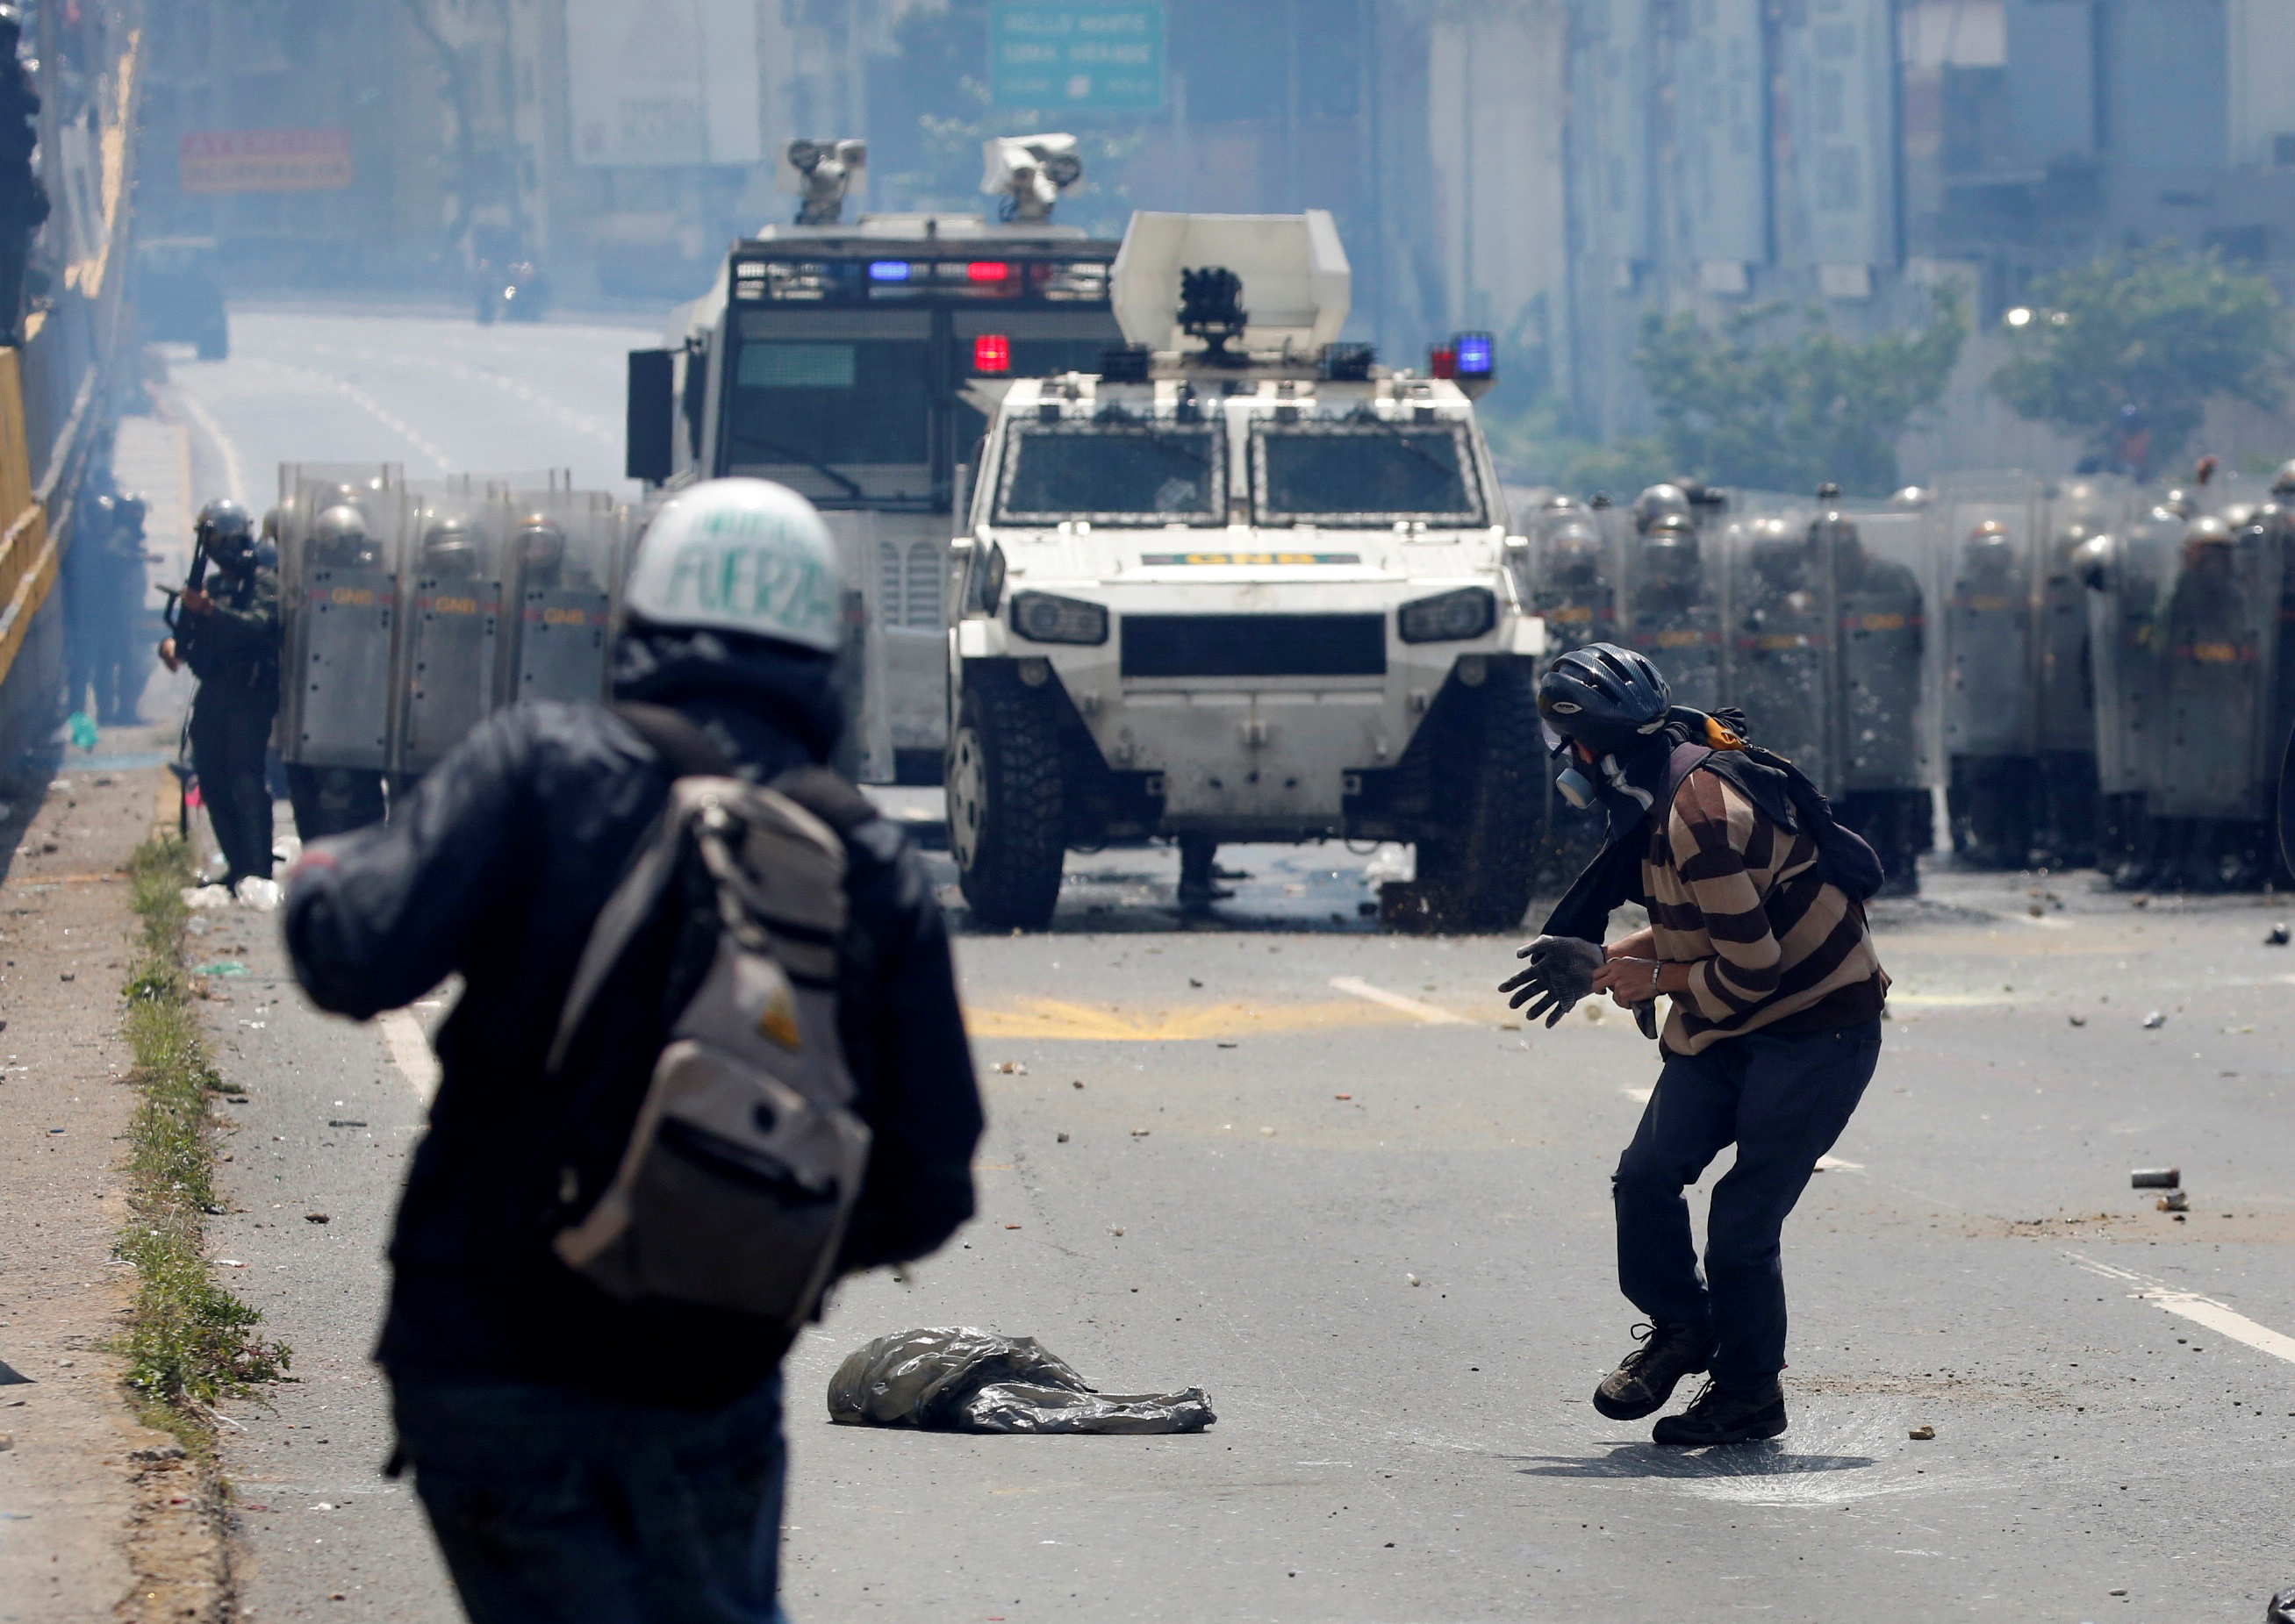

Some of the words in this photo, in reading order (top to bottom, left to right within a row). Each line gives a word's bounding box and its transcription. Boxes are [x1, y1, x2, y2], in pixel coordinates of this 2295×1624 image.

[332, 587, 374, 606] GNB
[435, 596, 477, 613] GNB
[544, 609, 585, 626] GNB
